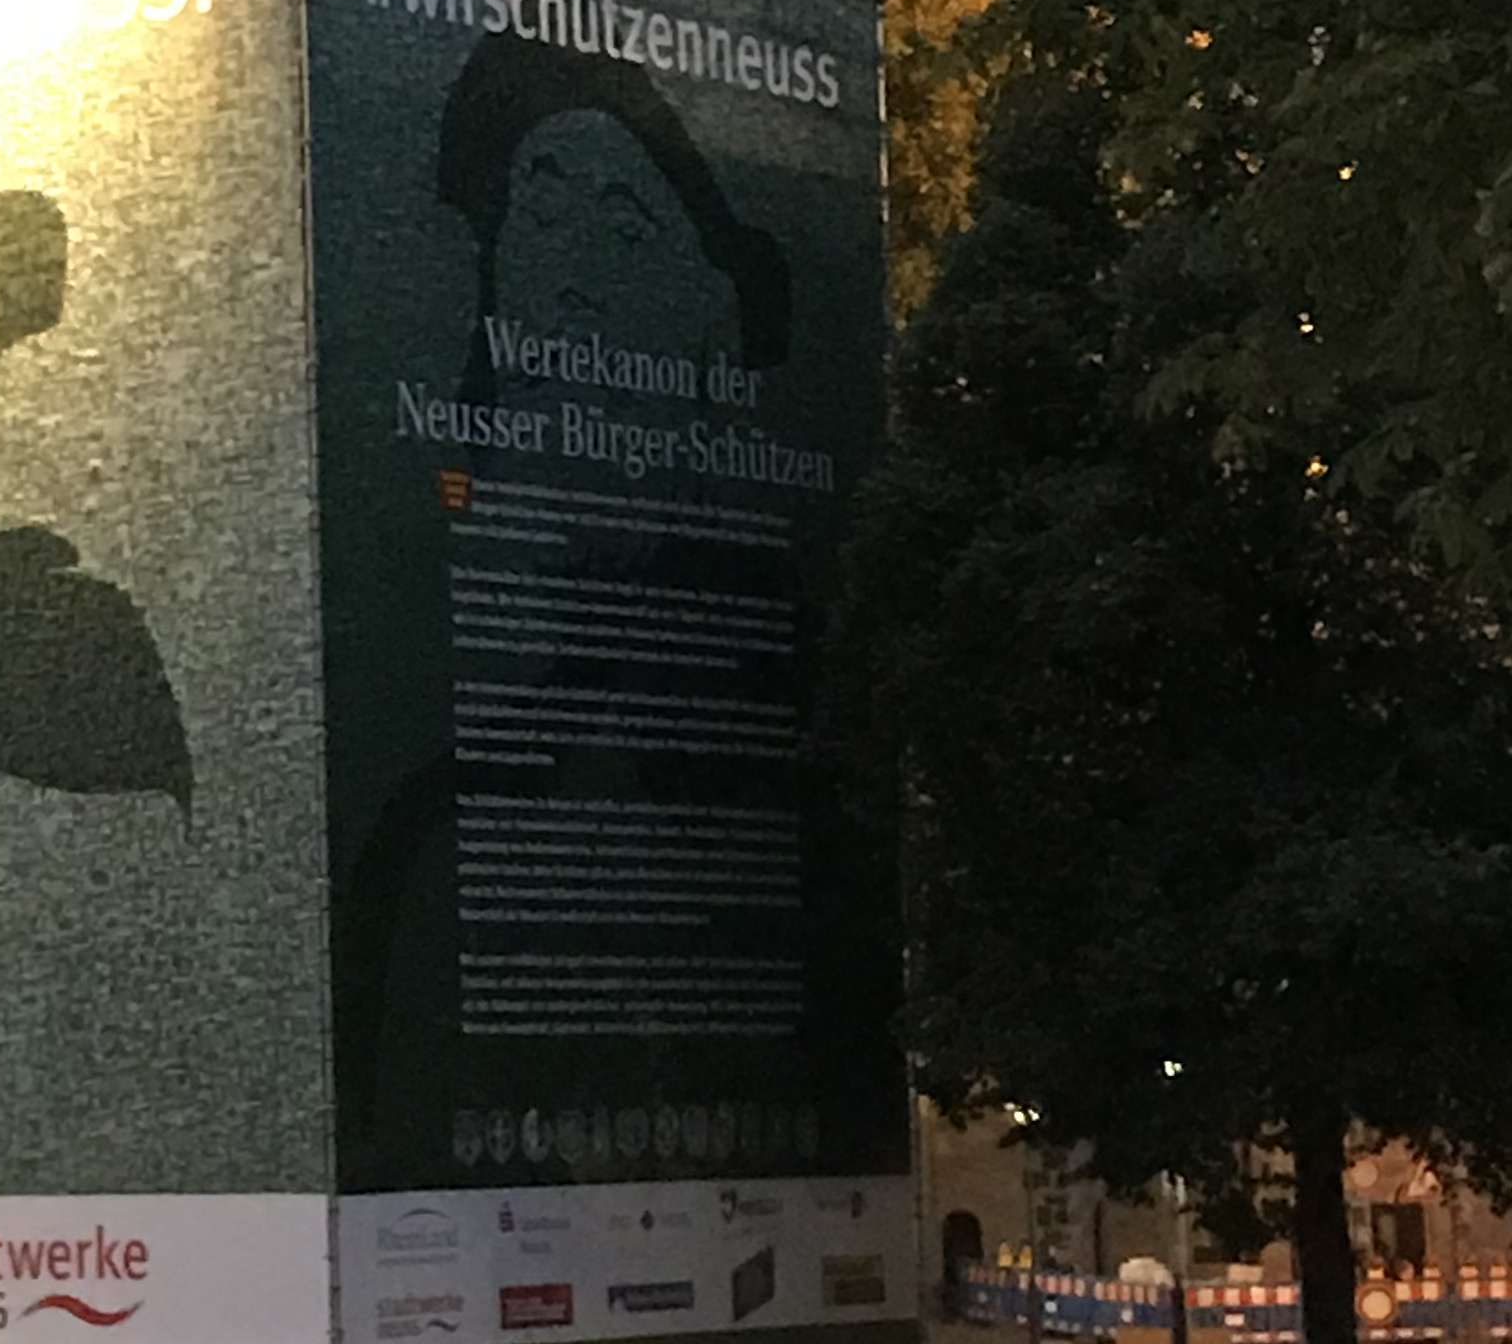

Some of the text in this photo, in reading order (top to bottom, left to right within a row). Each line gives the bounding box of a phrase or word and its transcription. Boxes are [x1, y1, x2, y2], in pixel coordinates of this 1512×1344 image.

[483, 316, 763, 408] Wertekanon der
[395, 379, 551, 454] Neusser
[561, 400, 836, 493] Bürger-Schützen
